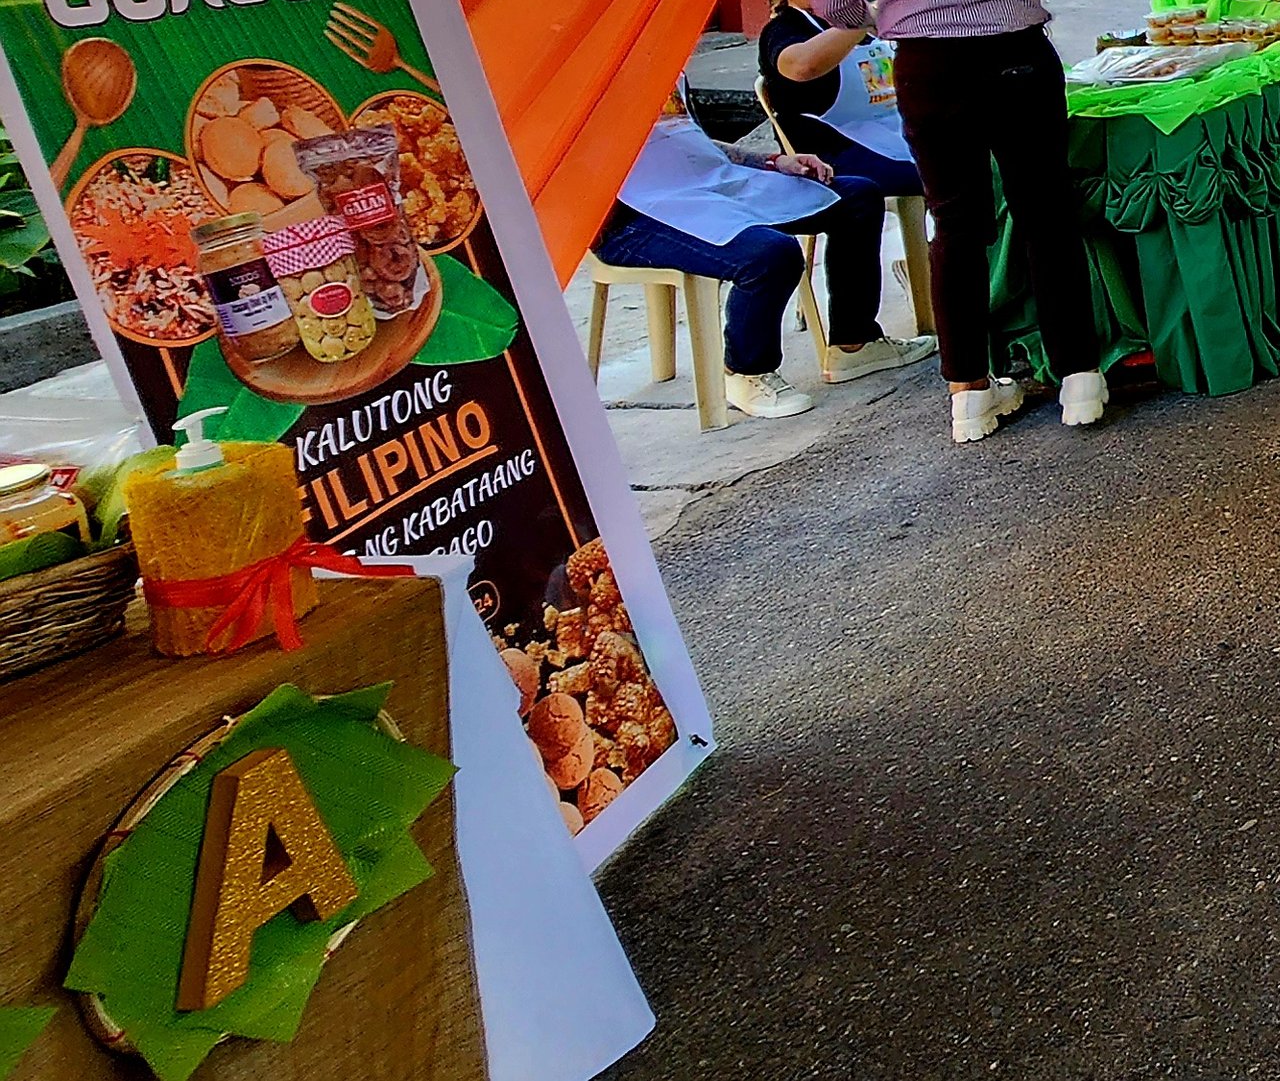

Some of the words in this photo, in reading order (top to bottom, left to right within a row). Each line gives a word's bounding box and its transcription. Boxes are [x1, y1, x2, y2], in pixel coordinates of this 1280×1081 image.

[296, 369, 452, 471] KALUTONG
[403, 449, 536, 545] KABATAANG
[178, 749, 358, 1012] A
